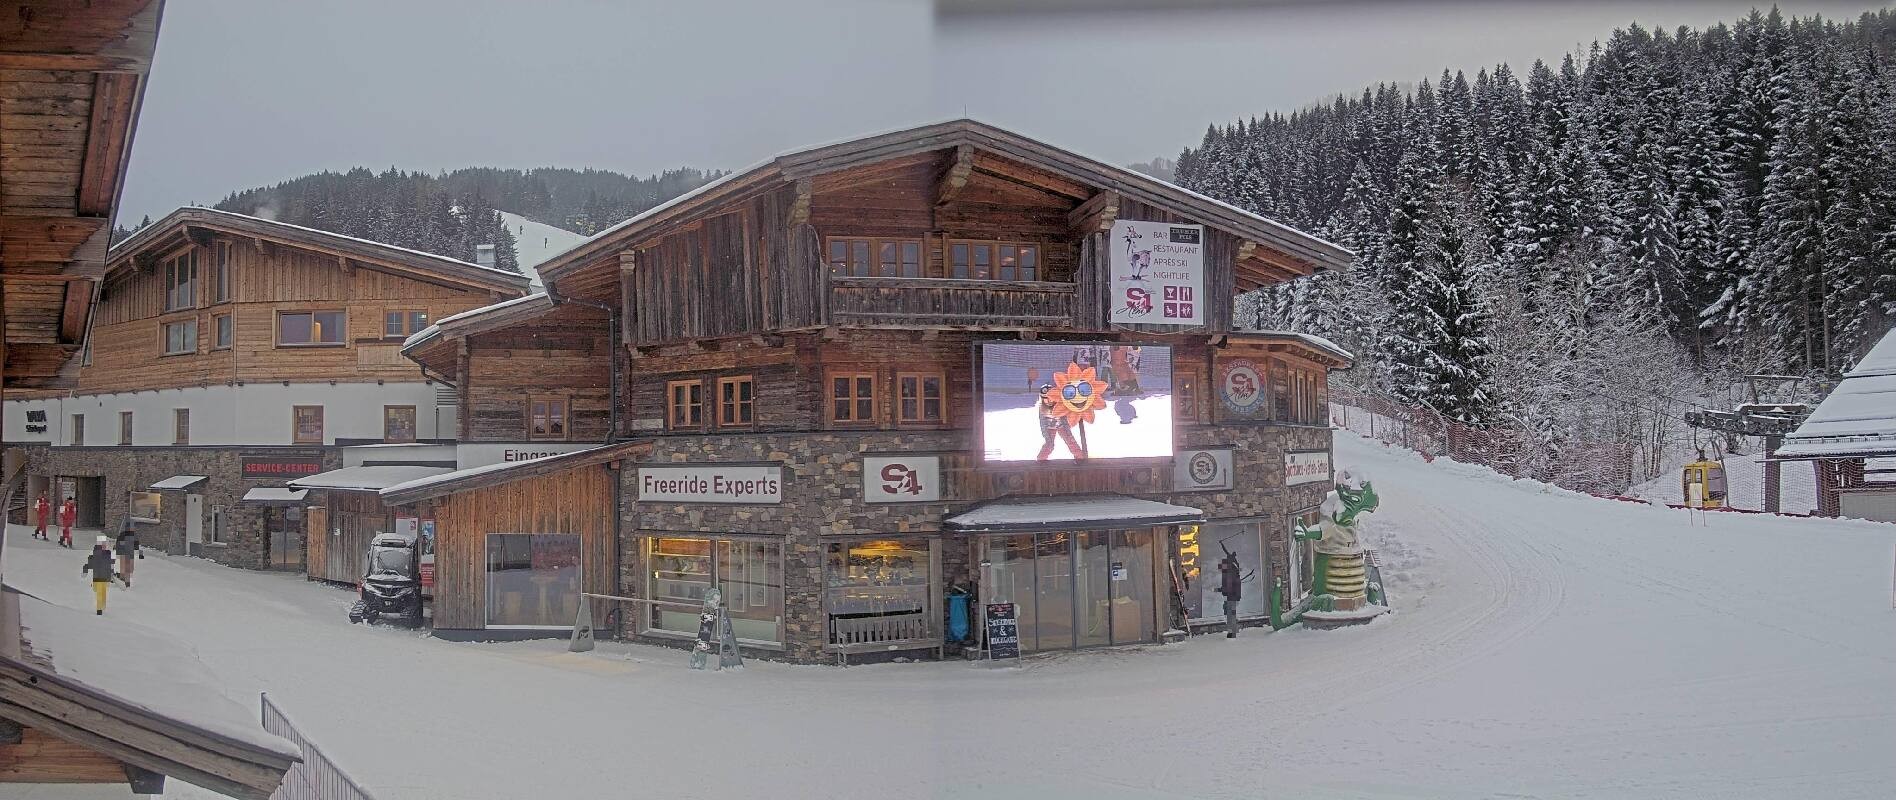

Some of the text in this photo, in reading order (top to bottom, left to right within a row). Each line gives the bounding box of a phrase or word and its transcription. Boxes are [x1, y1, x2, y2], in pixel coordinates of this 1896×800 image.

[1153, 231, 1168, 240] BAR
[1153, 245, 1199, 254] RESTAURANT
[1177, 259, 1188, 267] SKI
[1153, 271, 1190, 280] NIGHTLIFE
[246, 463, 320, 473] SERVICE-CENTER
[644, 475, 778, 497] Freeride Experts
